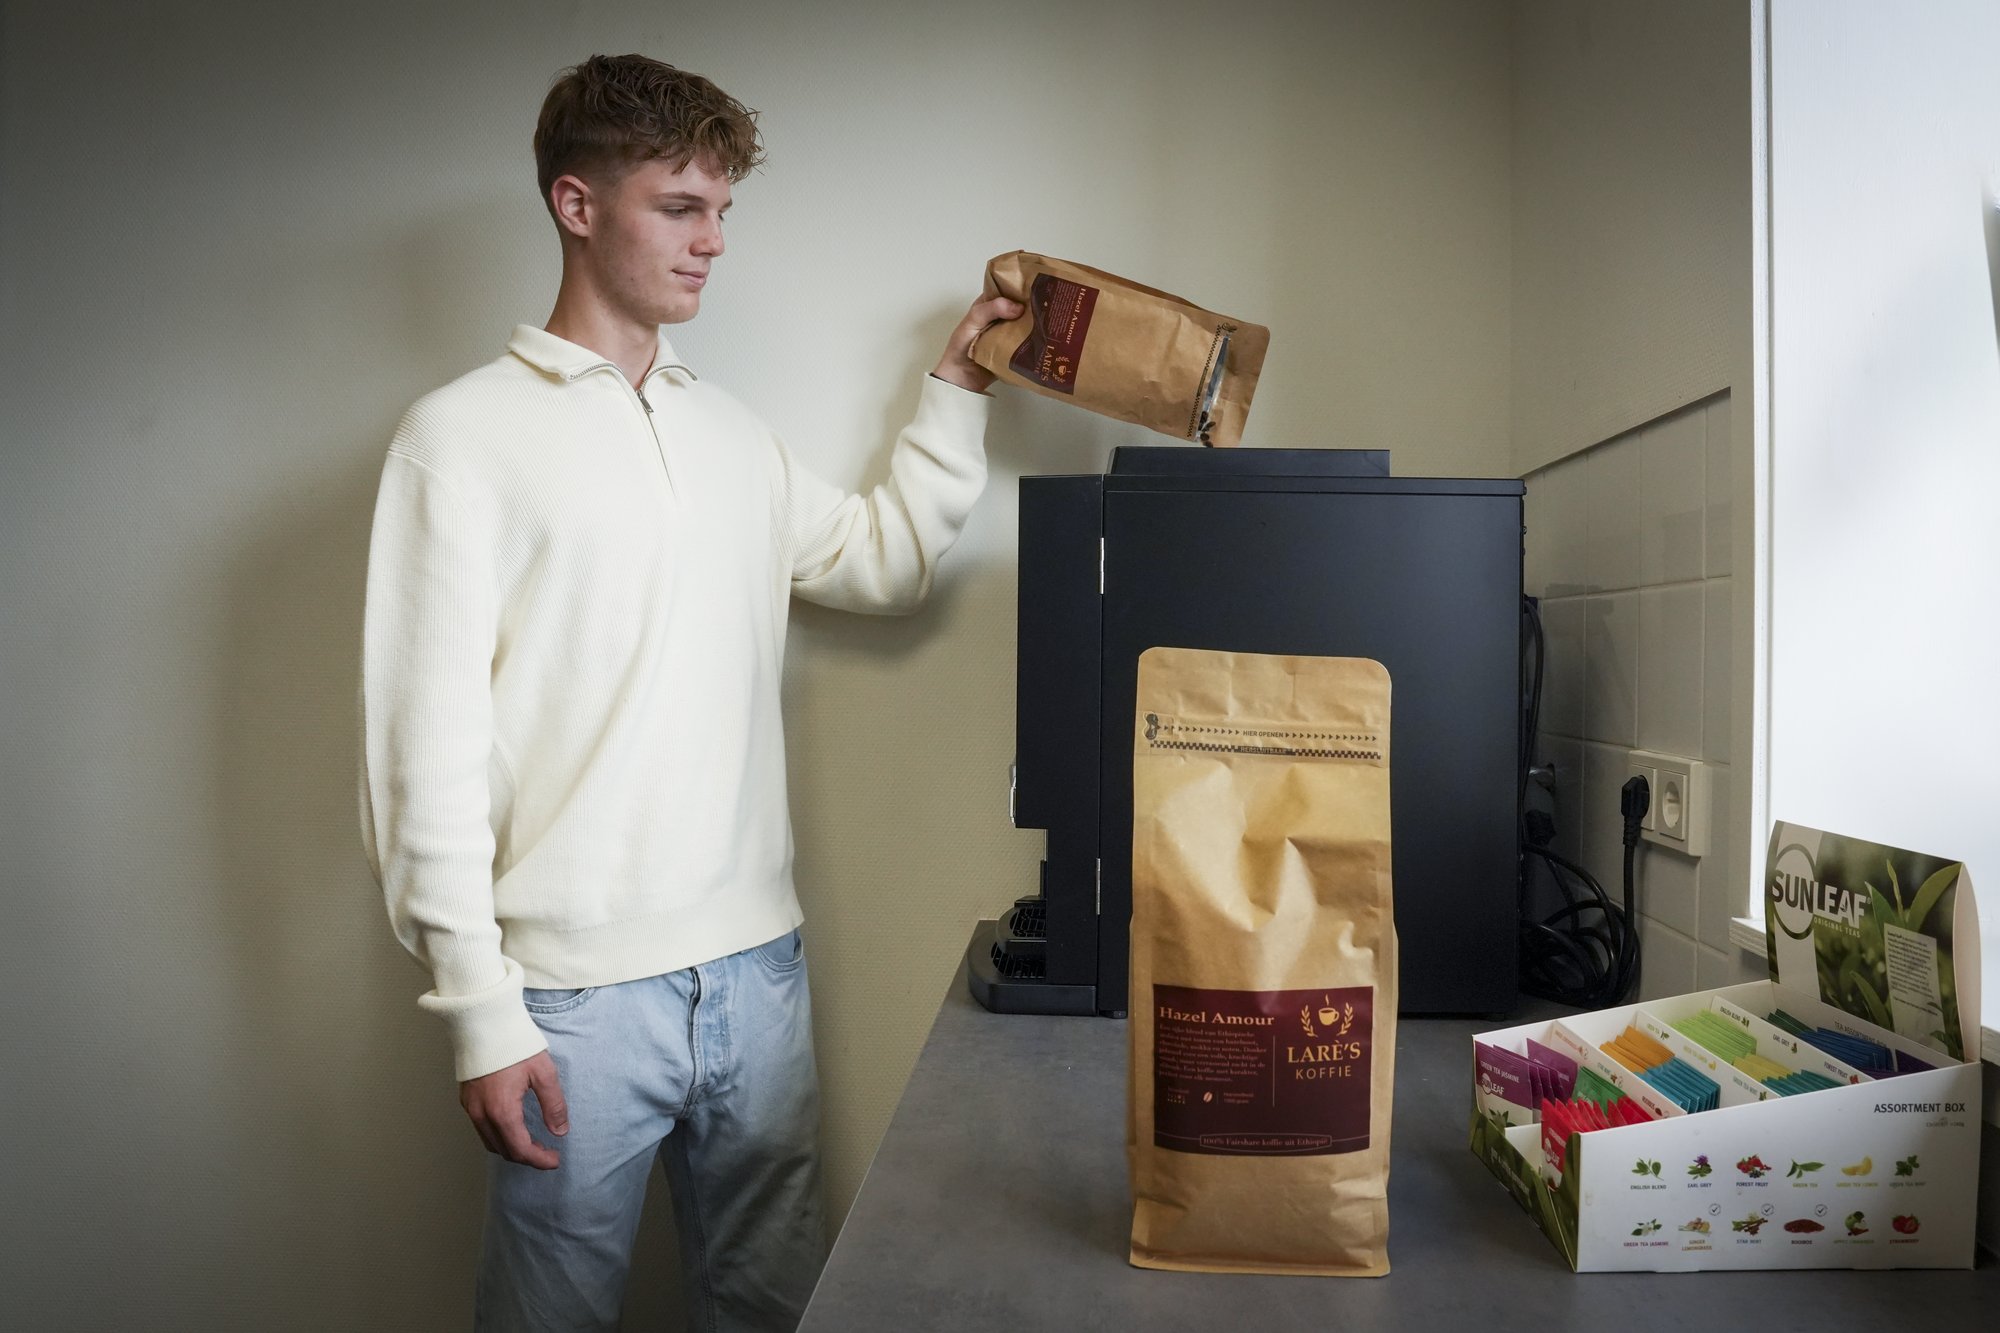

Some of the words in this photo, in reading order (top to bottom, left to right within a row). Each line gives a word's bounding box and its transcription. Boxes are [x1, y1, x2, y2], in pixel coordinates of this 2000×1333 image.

[1074, 287, 1087, 313] Hazel
[1066, 315, 1079, 344] Amour
[1769, 869, 1867, 929] SUNLEAF
[1813, 916, 1843, 932] ORIGINAL
[1845, 927, 1861, 938] TEAS
[1159, 1006, 1206, 1023] Hazel
[1212, 1012, 1275, 1026] Amour
[1287, 1040, 1361, 1064] LARÈ'S
[1296, 1065, 1352, 1080] KOFFIE
[1874, 1103, 1941, 1113] ASSORTMENT
[1944, 1102, 1966, 1112] BOX
